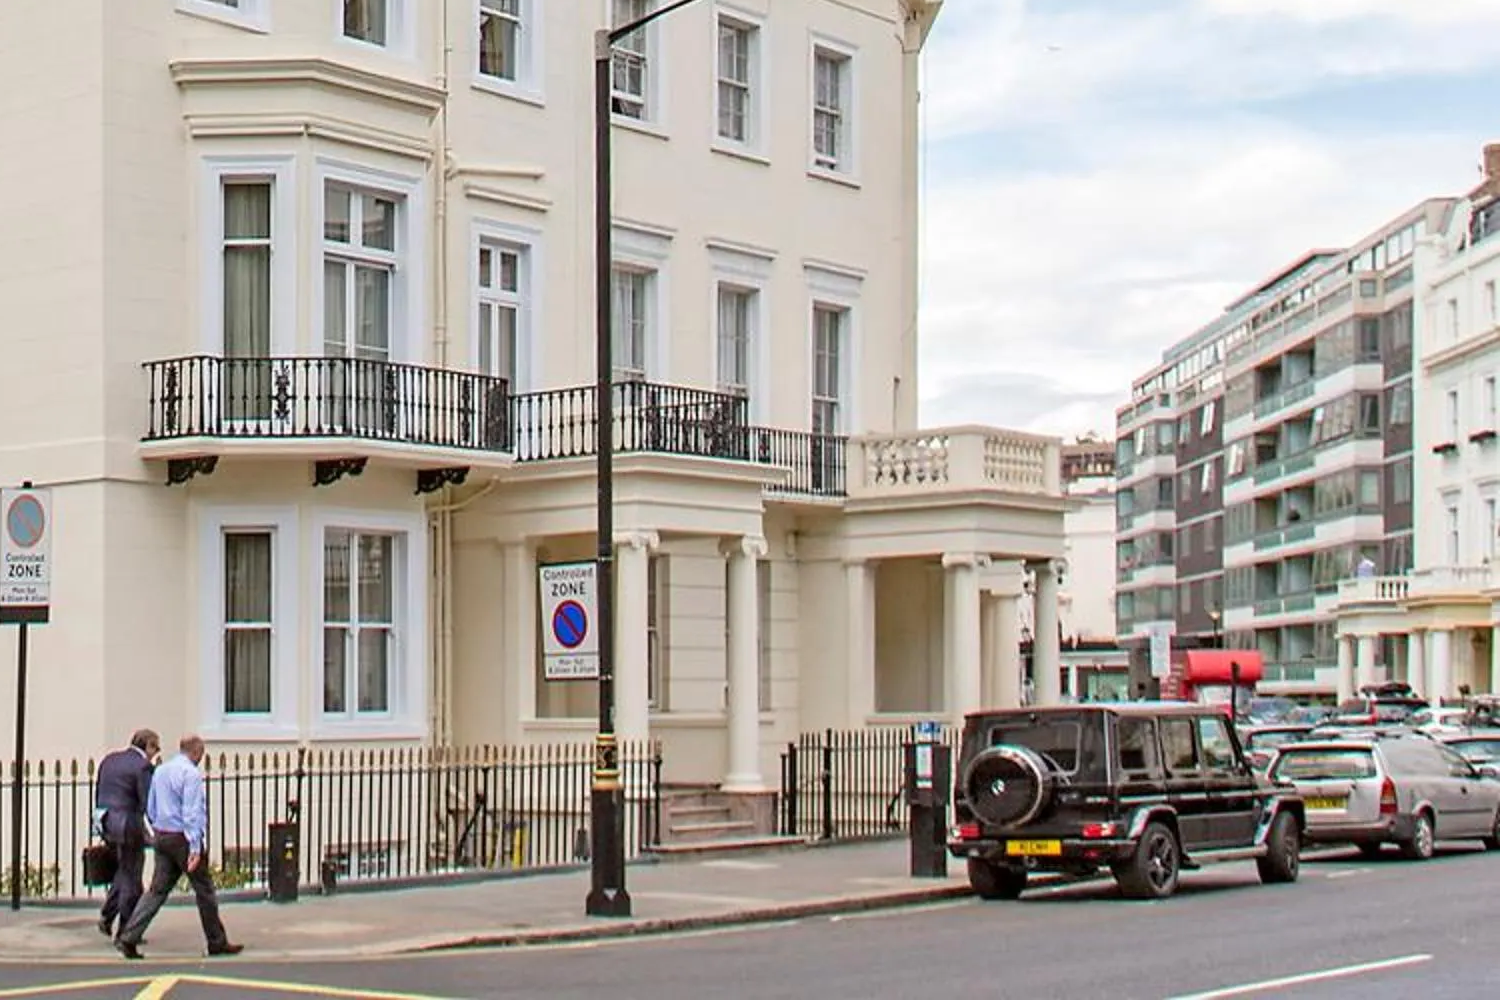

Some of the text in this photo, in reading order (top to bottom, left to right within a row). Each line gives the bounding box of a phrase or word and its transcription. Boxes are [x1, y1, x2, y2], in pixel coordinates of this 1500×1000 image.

[6, 553, 45, 562] Controlled
[8, 564, 41, 577] ZONE
[543, 567, 593, 581] Controlled
[551, 582, 587, 597] ZONE
